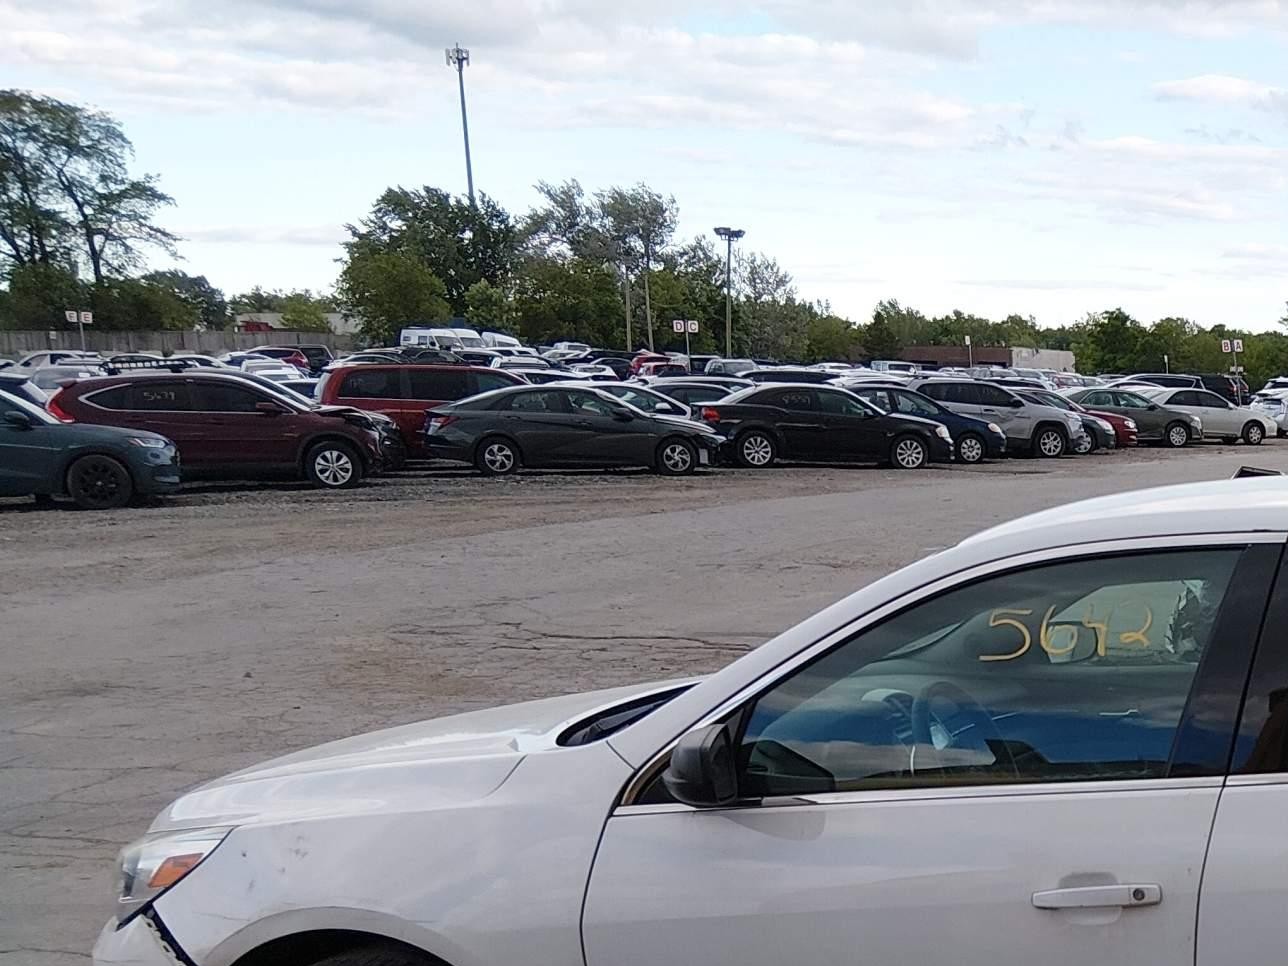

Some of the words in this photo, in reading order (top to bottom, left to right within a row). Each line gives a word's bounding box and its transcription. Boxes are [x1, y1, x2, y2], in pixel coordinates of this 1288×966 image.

[675, 321, 683, 331] D
[690, 322, 697, 331] C
[1223, 341, 1230, 352] B
[1235, 341, 1242, 350] A
[979, 604, 1152, 661] 5642
